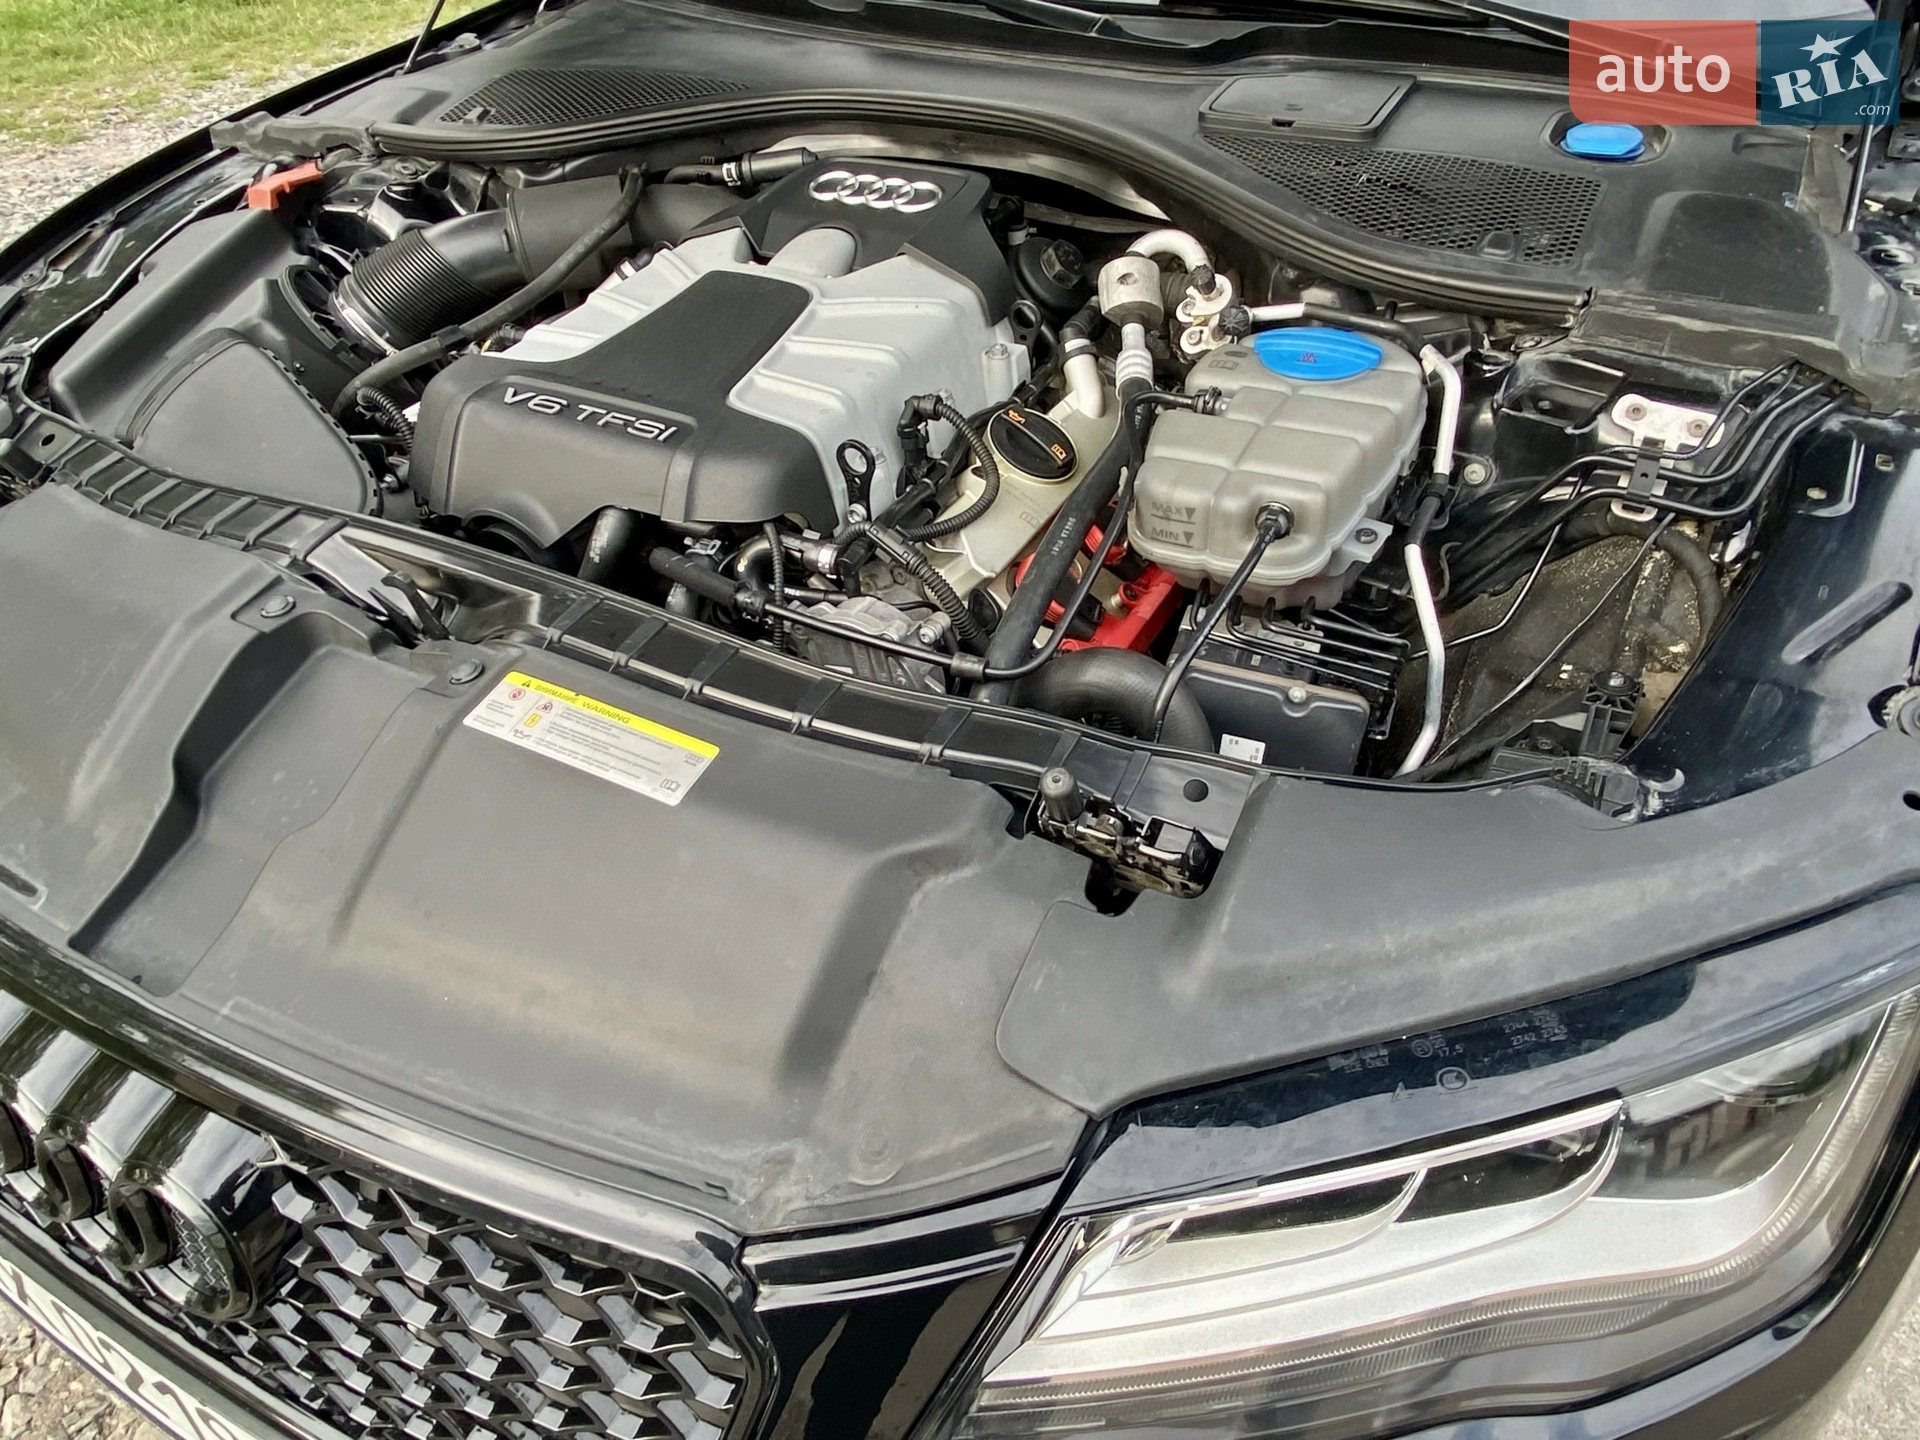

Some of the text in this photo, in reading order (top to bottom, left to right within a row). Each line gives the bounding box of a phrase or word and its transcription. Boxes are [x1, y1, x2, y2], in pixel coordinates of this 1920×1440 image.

[503, 386, 678, 442] V6 TFSI
[1151, 501, 1183, 517] MAX
[1151, 526, 1179, 541] MIN
[582, 701, 631, 724] WARNING
